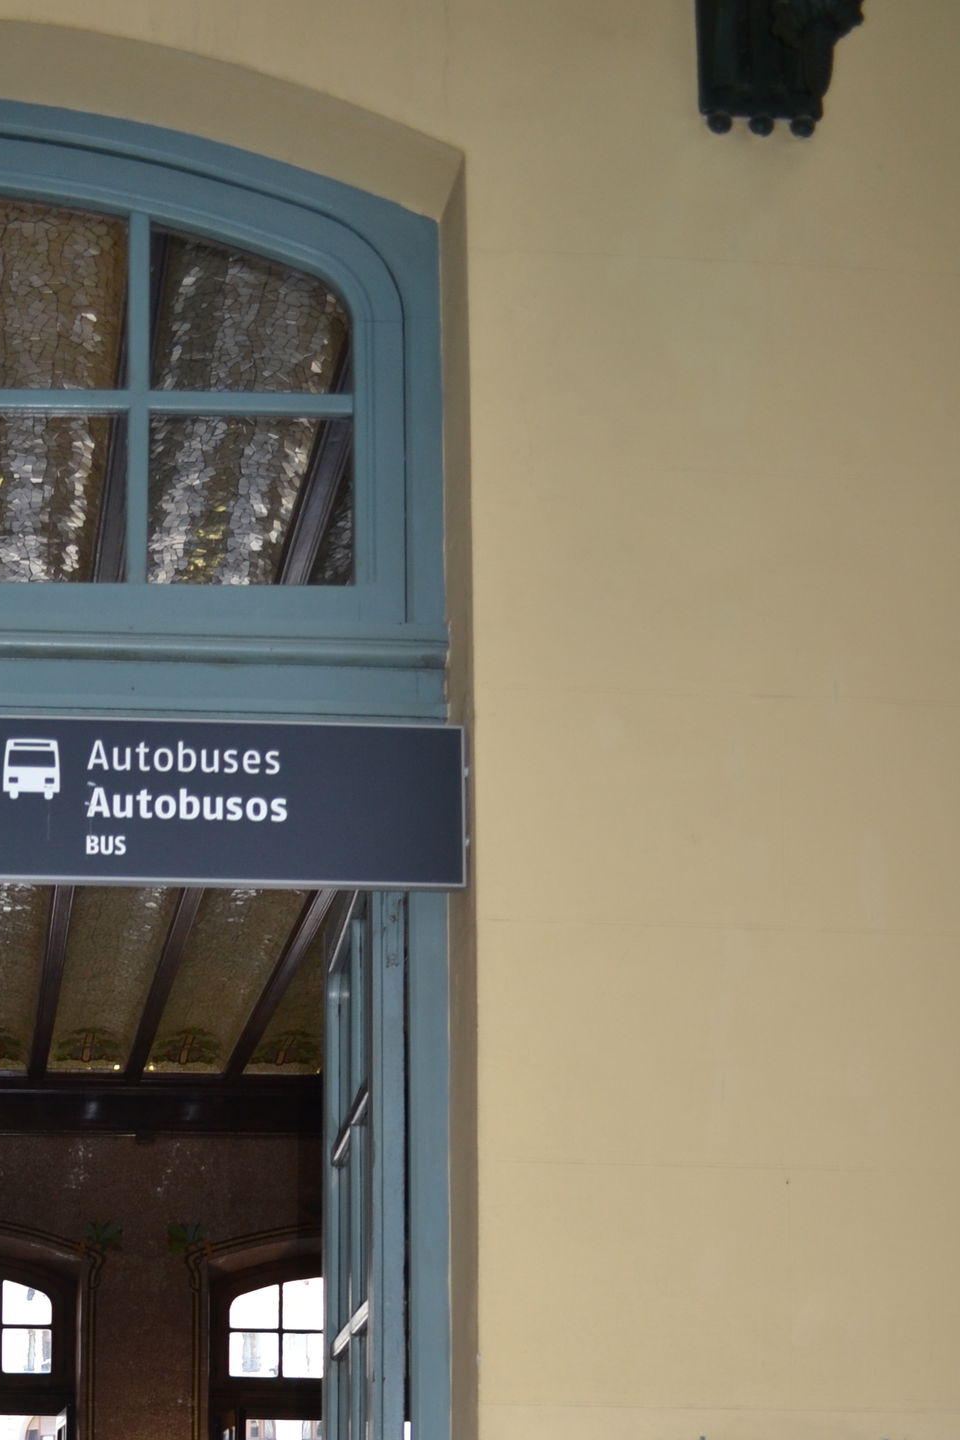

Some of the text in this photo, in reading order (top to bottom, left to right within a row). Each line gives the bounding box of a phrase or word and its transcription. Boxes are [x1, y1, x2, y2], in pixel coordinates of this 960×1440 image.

[87, 740, 281, 774] Autobuses
[86, 786, 288, 823] Autobusos
[85, 834, 127, 856] BUS
